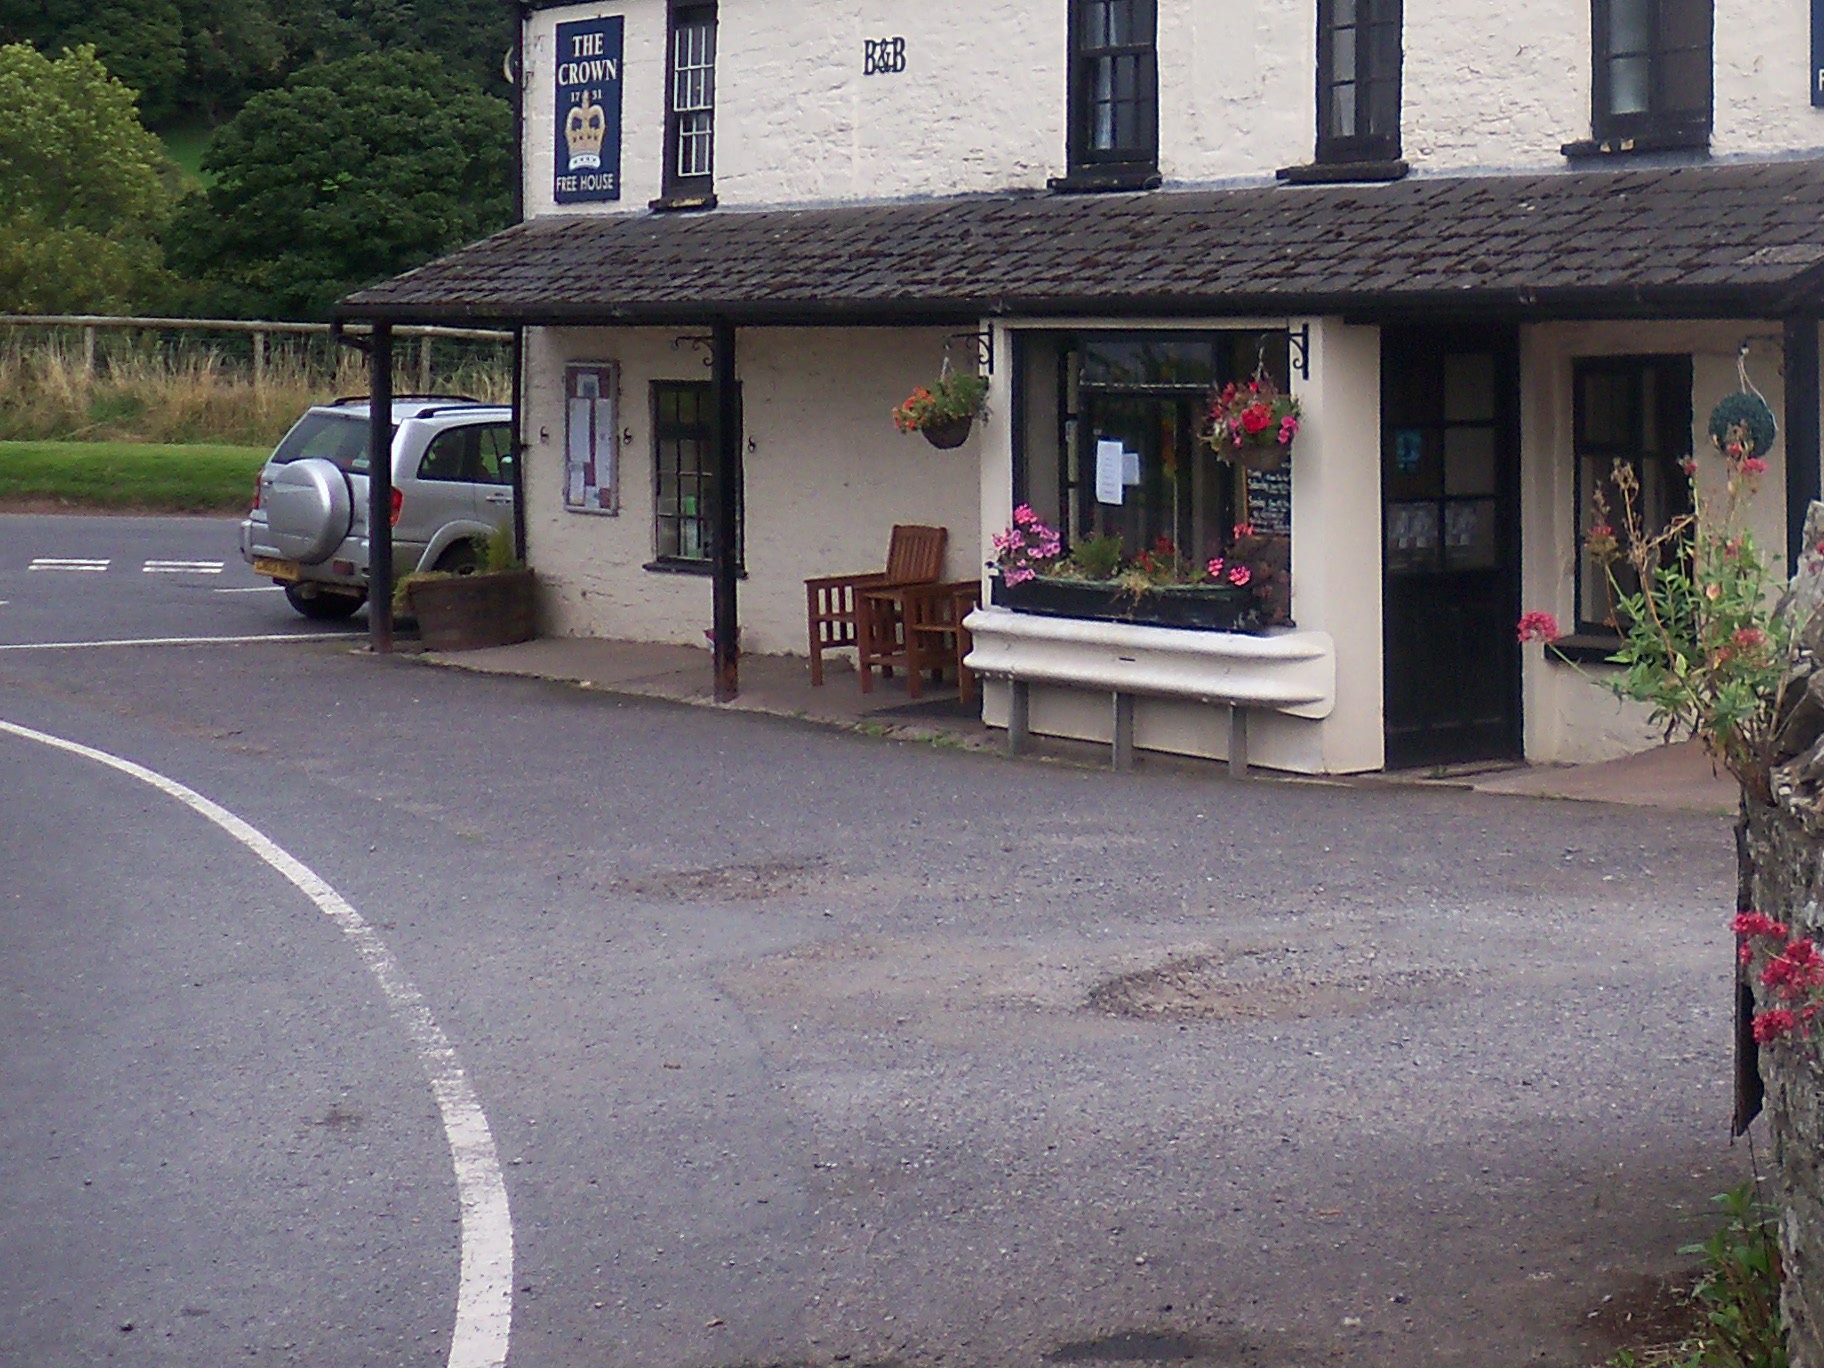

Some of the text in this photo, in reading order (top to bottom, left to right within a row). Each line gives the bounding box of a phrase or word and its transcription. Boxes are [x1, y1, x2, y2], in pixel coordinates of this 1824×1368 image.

[573, 33, 604, 57] THE
[863, 36, 906, 75] B&B
[558, 59, 617, 86] CROWN
[556, 173, 614, 192] FREE HOUSE
